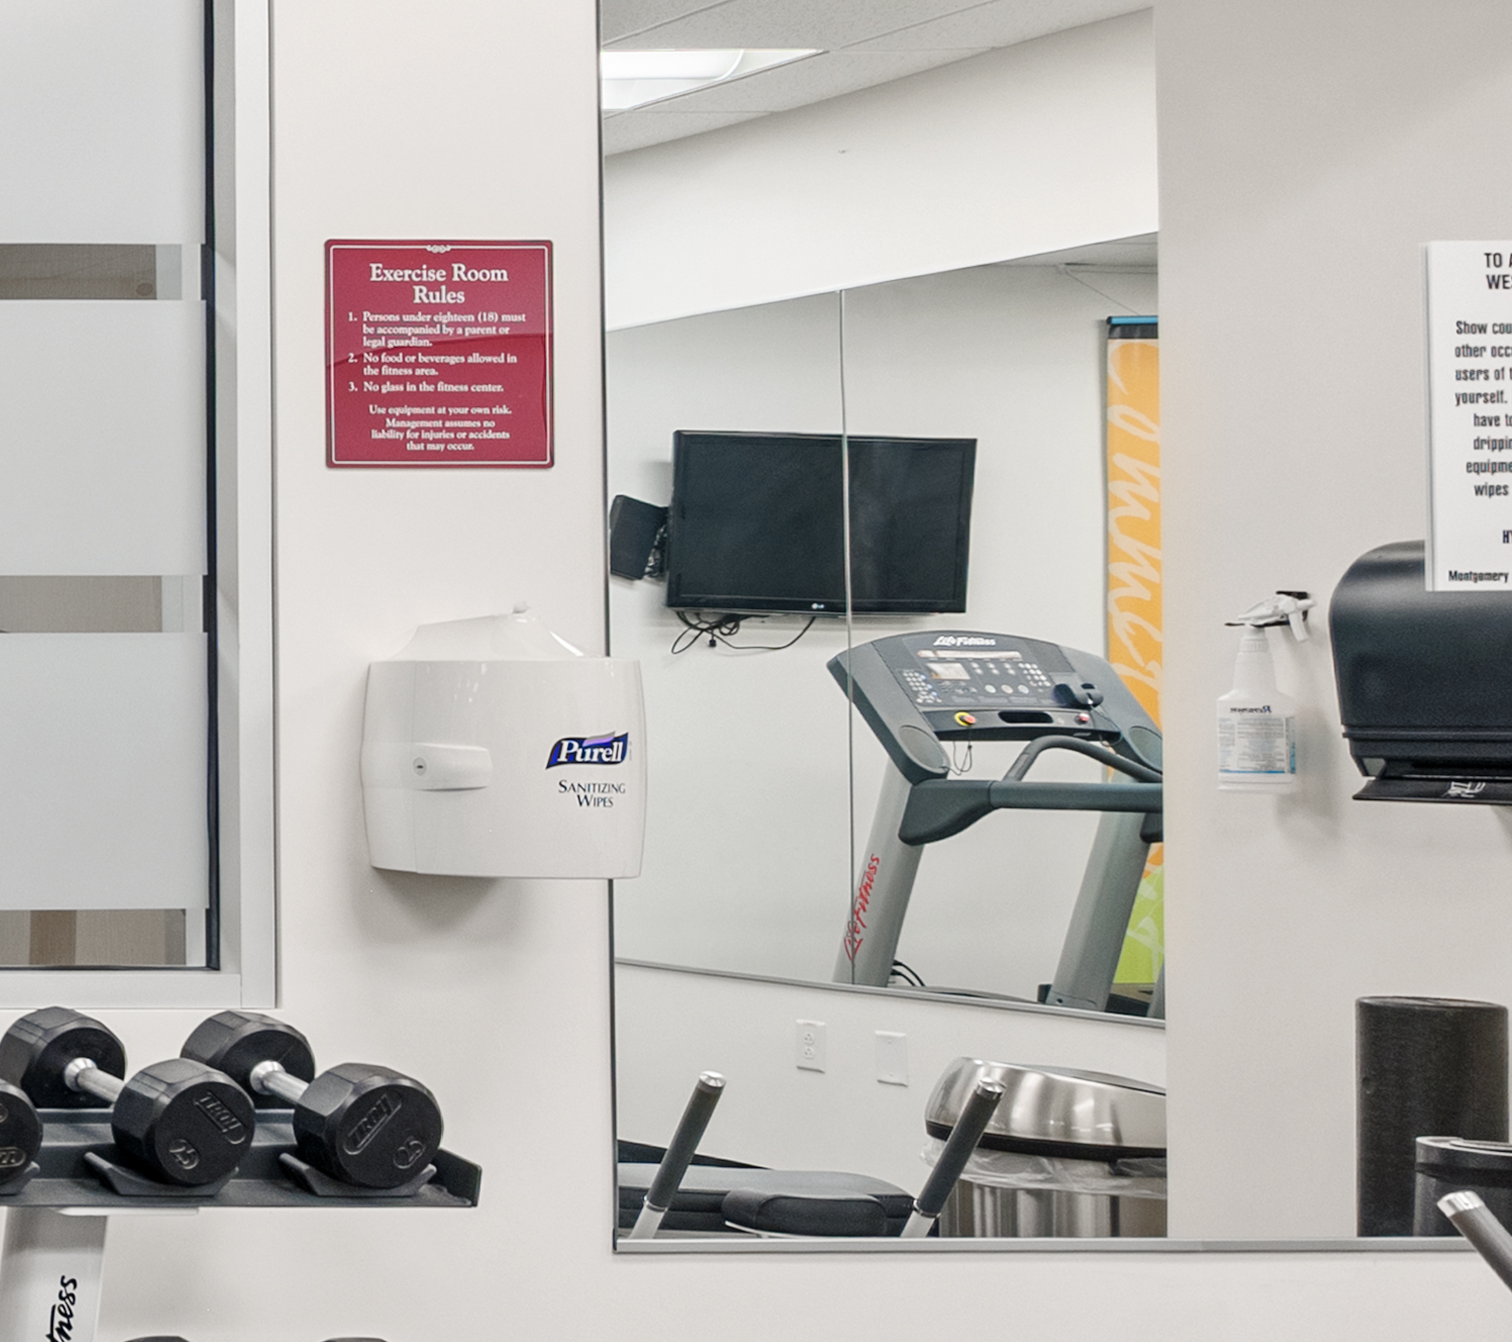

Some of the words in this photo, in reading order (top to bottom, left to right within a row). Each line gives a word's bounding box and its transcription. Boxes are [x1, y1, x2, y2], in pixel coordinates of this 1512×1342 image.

[1484, 253, 1502, 268] TO
[370, 263, 446, 282] Exercise
[452, 263, 508, 282] Room
[1486, 274, 1512, 289] WE
[413, 285, 465, 304] Rules
[348, 312, 357, 322] 1.
[363, 312, 400, 322] Persons
[402, 312, 431, 322] under
[433, 312, 474, 324] eighteen
[478, 312, 498, 324] (18)
[501, 312, 526, 322] must
[363, 324, 374, 335] be
[377, 324, 440, 337] accompanied
[442, 324, 454, 337] by
[457, 327, 462, 335] a
[465, 324, 496, 337] parent
[499, 327, 510, 335] or
[1456, 321, 1487, 334] Show
[363, 337, 385, 349] legal
[388, 337, 432, 349] guardian.
[1455, 345, 1486, 357] other
[348, 353, 357, 363] 2.
[364, 353, 379, 363] No
[381, 353, 403, 363] food
[418, 353, 465, 365] beverages
[467, 353, 504, 363] allowed
[507, 353, 517, 363] in
[364, 366, 379, 375] the
[381, 366, 413, 375] fitness
[1455, 369, 1489, 380] users
[1494, 367, 1505, 380] of
[348, 382, 358, 392] 3.
[364, 382, 379, 392] No
[381, 382, 404, 394] glass
[407, 382, 417, 392] in
[419, 382, 435, 392] the
[437, 382, 468, 392] fitness
[471, 382, 504, 392] center.
[1455, 391, 1508, 406] yourself.
[369, 405, 386, 415] Use
[388, 405, 435, 416] equipment
[437, 405, 446, 415] at
[448, 408, 469, 416] your
[492, 405, 512, 415] risk.
[385, 418, 442, 429] Management
[1473, 413, 1500, 426] have
[371, 429, 404, 441] liability
[406, 429, 419, 439] for
[421, 429, 455, 441] injuries
[468, 429, 510, 439] accidents
[407, 441, 424, 451] that
[426, 444, 445, 452] may
[1474, 483, 1509, 497] wipes
[1448, 570, 1509, 582] Montgomery
[557, 740, 623, 764] Purell
[559, 779, 626, 794] SANITIZING
[576, 794, 614, 808] WIPES
